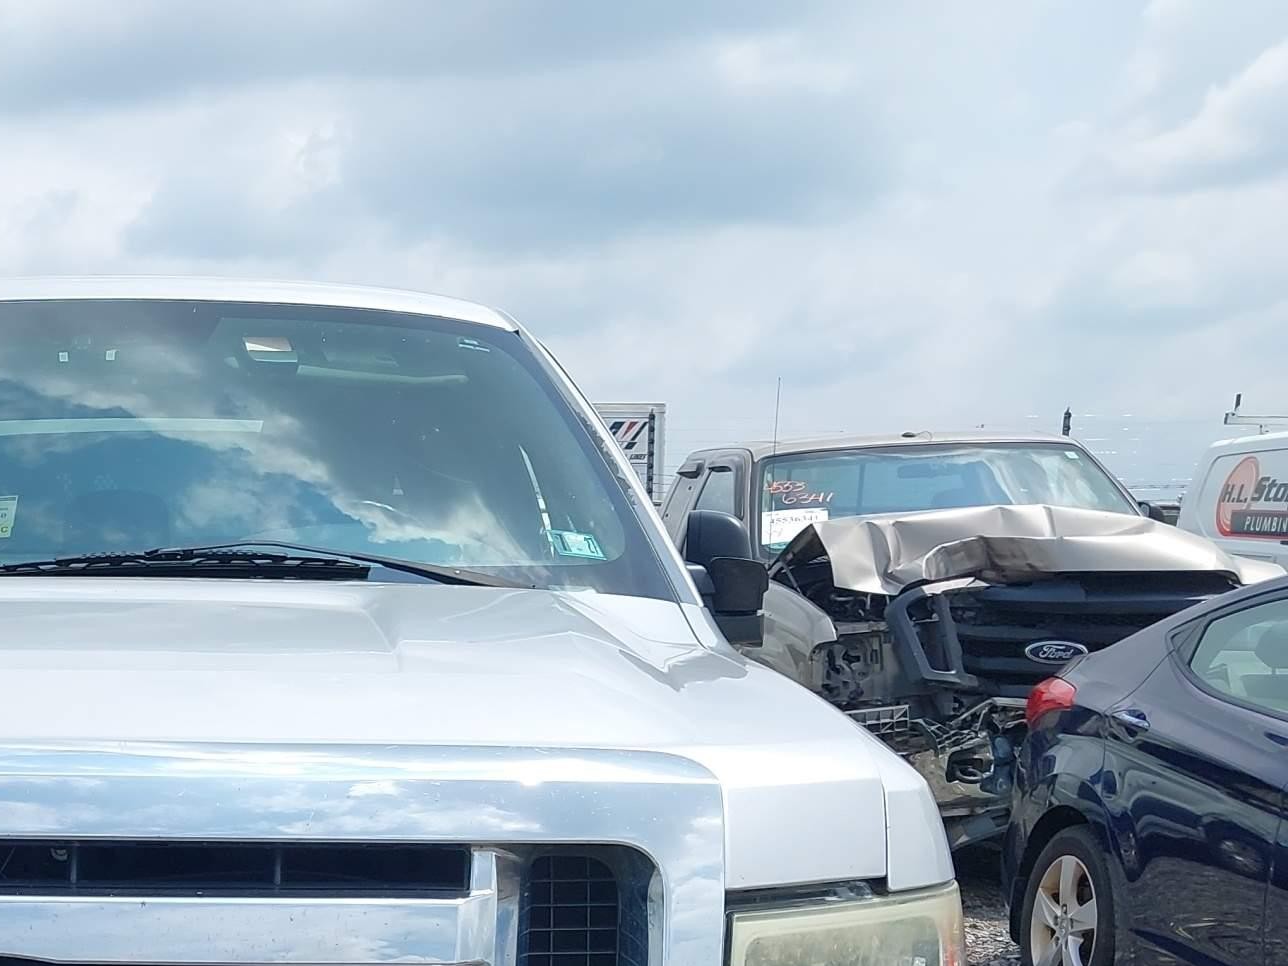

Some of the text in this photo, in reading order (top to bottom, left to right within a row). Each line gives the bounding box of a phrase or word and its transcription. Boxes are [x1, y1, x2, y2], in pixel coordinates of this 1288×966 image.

[782, 491, 834, 505] 6341
[1221, 483, 1248, 503] H.L.
[1038, 644, 1074, 659] Ford
